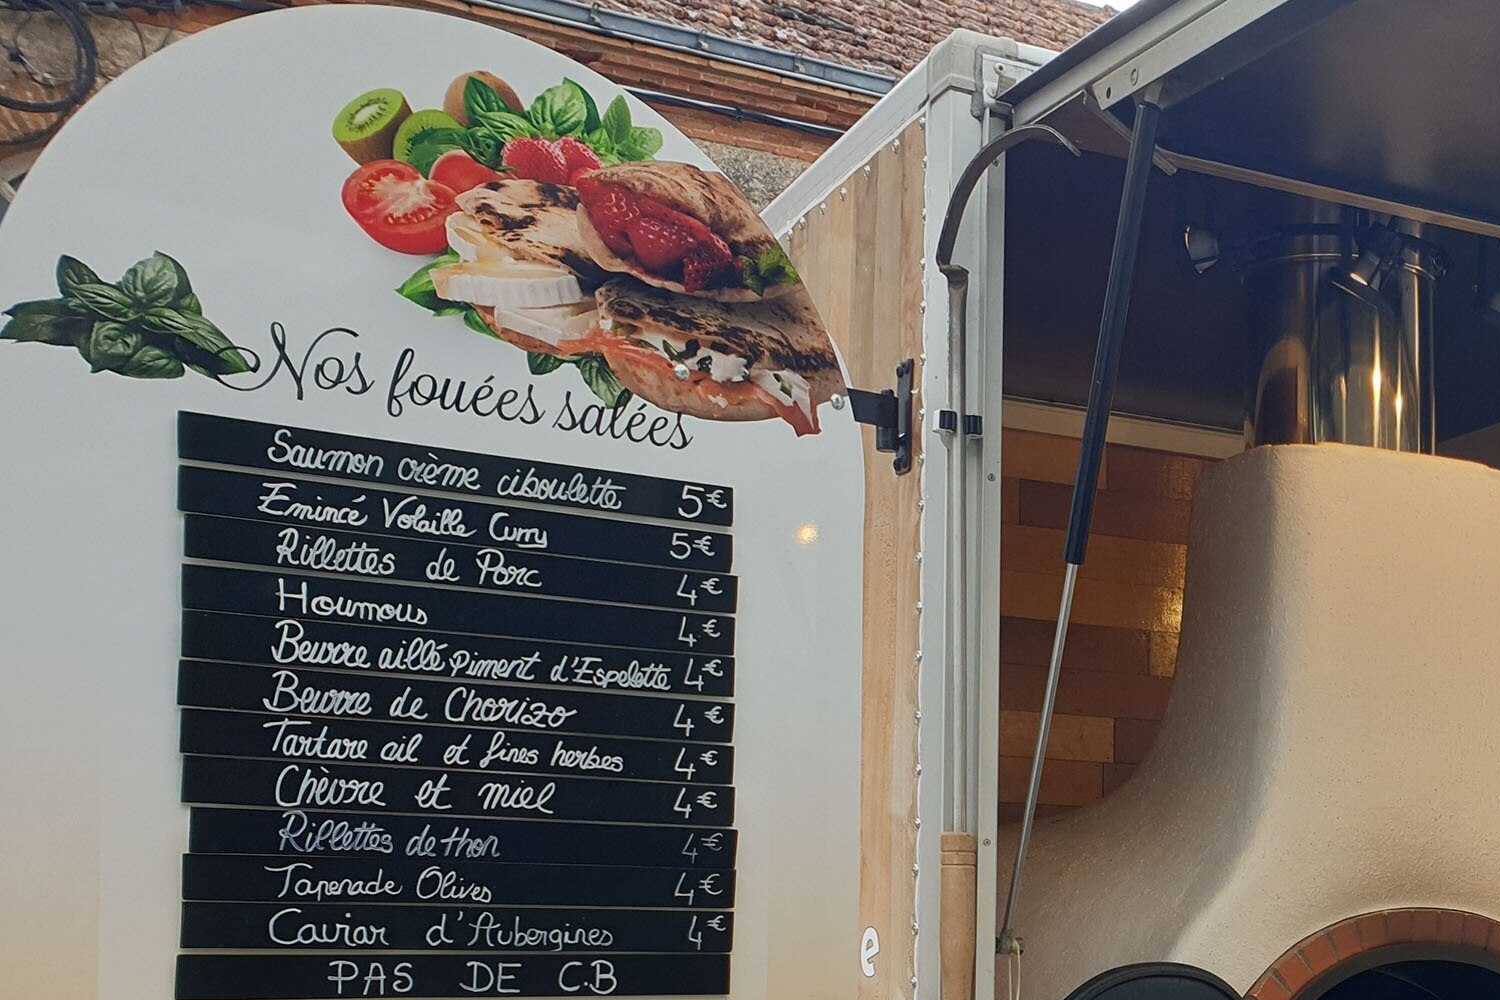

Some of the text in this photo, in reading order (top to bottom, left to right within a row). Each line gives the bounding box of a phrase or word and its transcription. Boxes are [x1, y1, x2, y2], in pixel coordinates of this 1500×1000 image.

[214, 321, 694, 450] Nos fouées salées
[267, 429, 384, 477] Saumon
[398, 452, 481, 490] crème
[496, 467, 627, 510] ciboulette
[257, 483, 369, 525] Emincé
[382, 495, 477, 537] Volaille
[488, 511, 548, 548] Curry
[276, 527, 396, 575] Rillettes
[425, 547, 460, 581] de
[477, 548, 543, 588] Porc
[275, 577, 428, 625] Houmous
[271, 619, 371, 668] Beurre
[378, 636, 448, 672] aillé
[550, 654, 672, 692] d'Espelette
[262, 670, 373, 716] Beurre
[389, 686, 428, 720] de
[444, 686, 578, 728] Chorizo
[262, 717, 369, 760] Tartare
[379, 732, 423, 763] ail
[442, 733, 473, 766] et
[479, 731, 540, 768] fines
[550, 740, 624, 773] herbes
[275, 764, 387, 808] Chèvre
[414, 773, 453, 810] et
[477, 779, 556, 814] miel
[278, 809, 394, 854] Rillettes
[405, 823, 438, 857] de
[440, 826, 500, 858] thon
[264, 862, 403, 902] Tapenade
[416, 865, 492, 903] Olives
[268, 907, 390, 947] Caviar
[425, 911, 614, 951] d'Aubergines
[327, 960, 414, 995] PAS
[458, 961, 523, 994] DE
